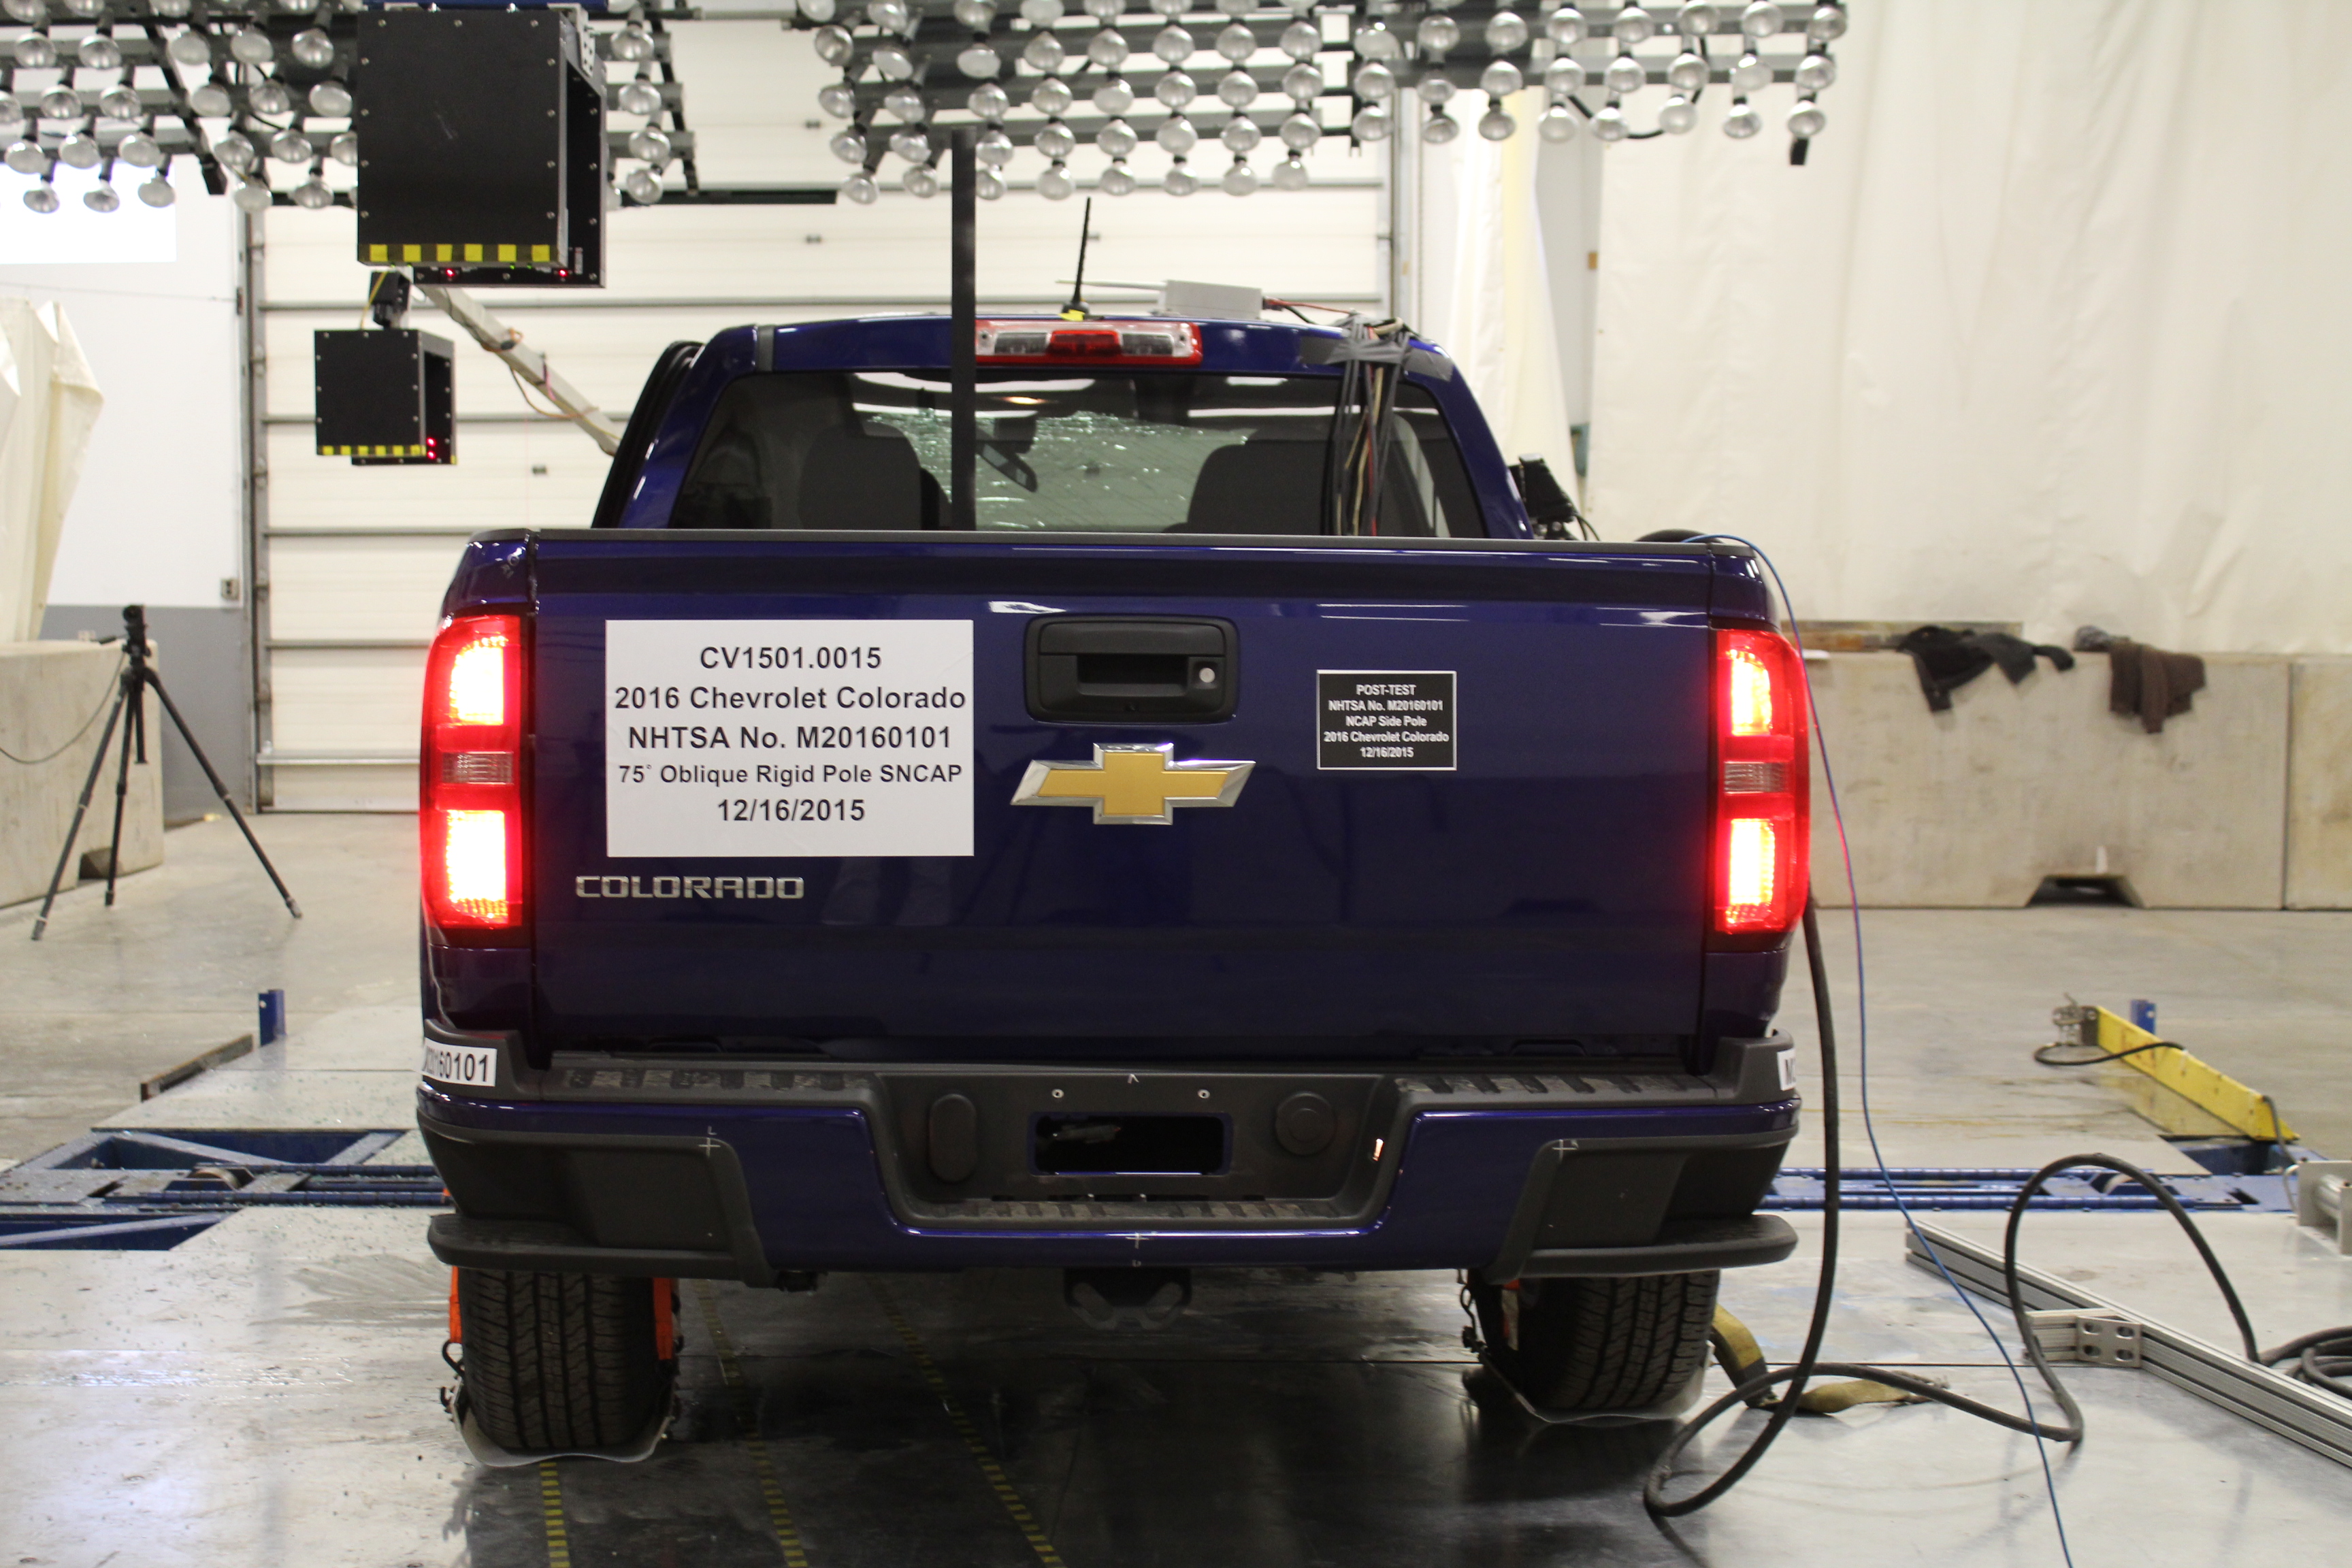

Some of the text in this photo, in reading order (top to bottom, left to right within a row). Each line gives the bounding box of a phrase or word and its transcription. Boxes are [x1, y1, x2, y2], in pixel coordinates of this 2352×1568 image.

[700, 647, 882, 669] CV1501.0015
[615, 686, 966, 709] 2016 Chevrolet Colorado
[1356, 684, 1417, 696] POST-TEST
[1328, 700, 1443, 711] NHTSA No. M20160101
[1345, 715, 1428, 727] NCAP Side Pole
[629, 726, 950, 749] NHTSA No. M20160101
[1323, 730, 1450, 742] 2016 Chevrolet Colorado
[1359, 746, 1414, 758] 12/16/2015
[660, 764, 749, 787] Oblique
[756, 764, 815, 787] Rigid
[823, 764, 872, 783] Pole
[880, 764, 962, 783] SNCAP
[717, 798, 866, 821] 12/16/2015
[575, 875, 805, 899] COLORADO
